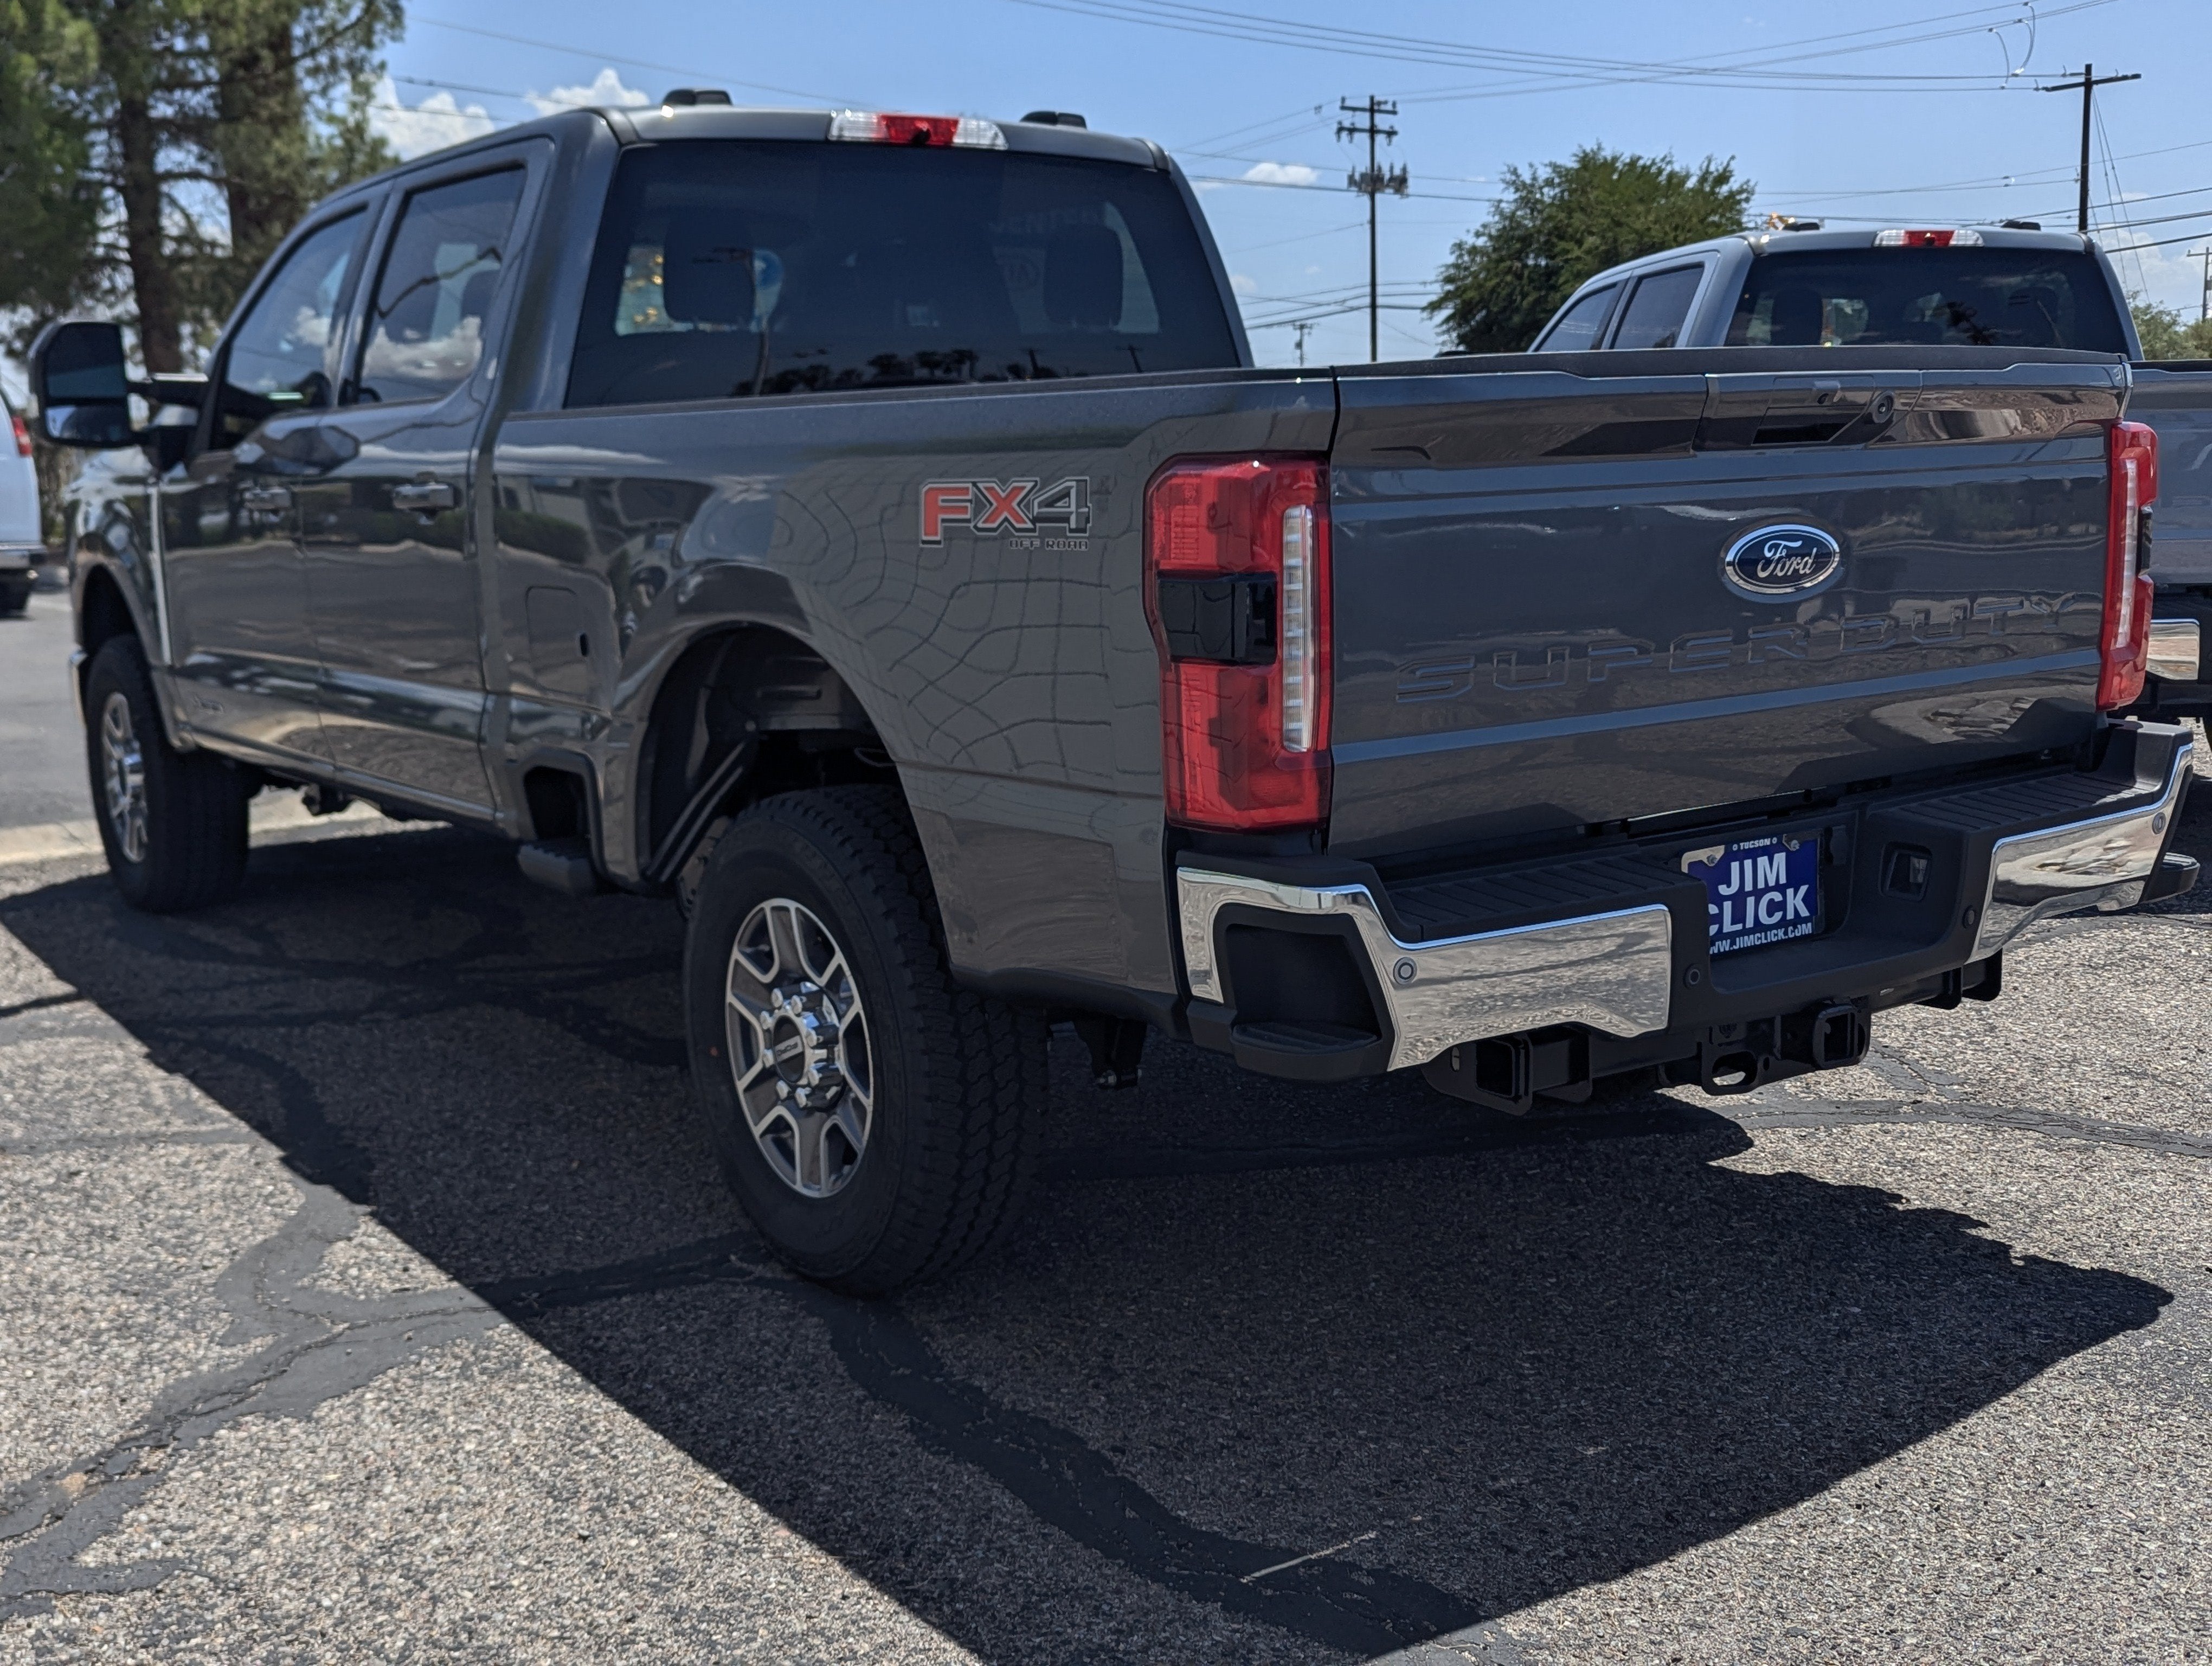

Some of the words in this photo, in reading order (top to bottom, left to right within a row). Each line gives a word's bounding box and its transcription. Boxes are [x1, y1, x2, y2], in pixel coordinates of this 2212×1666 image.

[919, 476, 1092, 547] FX4
[1009, 538, 1040, 549] OFF
[1045, 538, 1089, 551] ROAD
[1757, 540, 1817, 578] Ford
[1396, 620, 1810, 703] SUPER
[1840, 592, 2076, 652] DUTY
[1739, 838, 1771, 850] TUCSON
[1718, 852, 1786, 896] JIM
